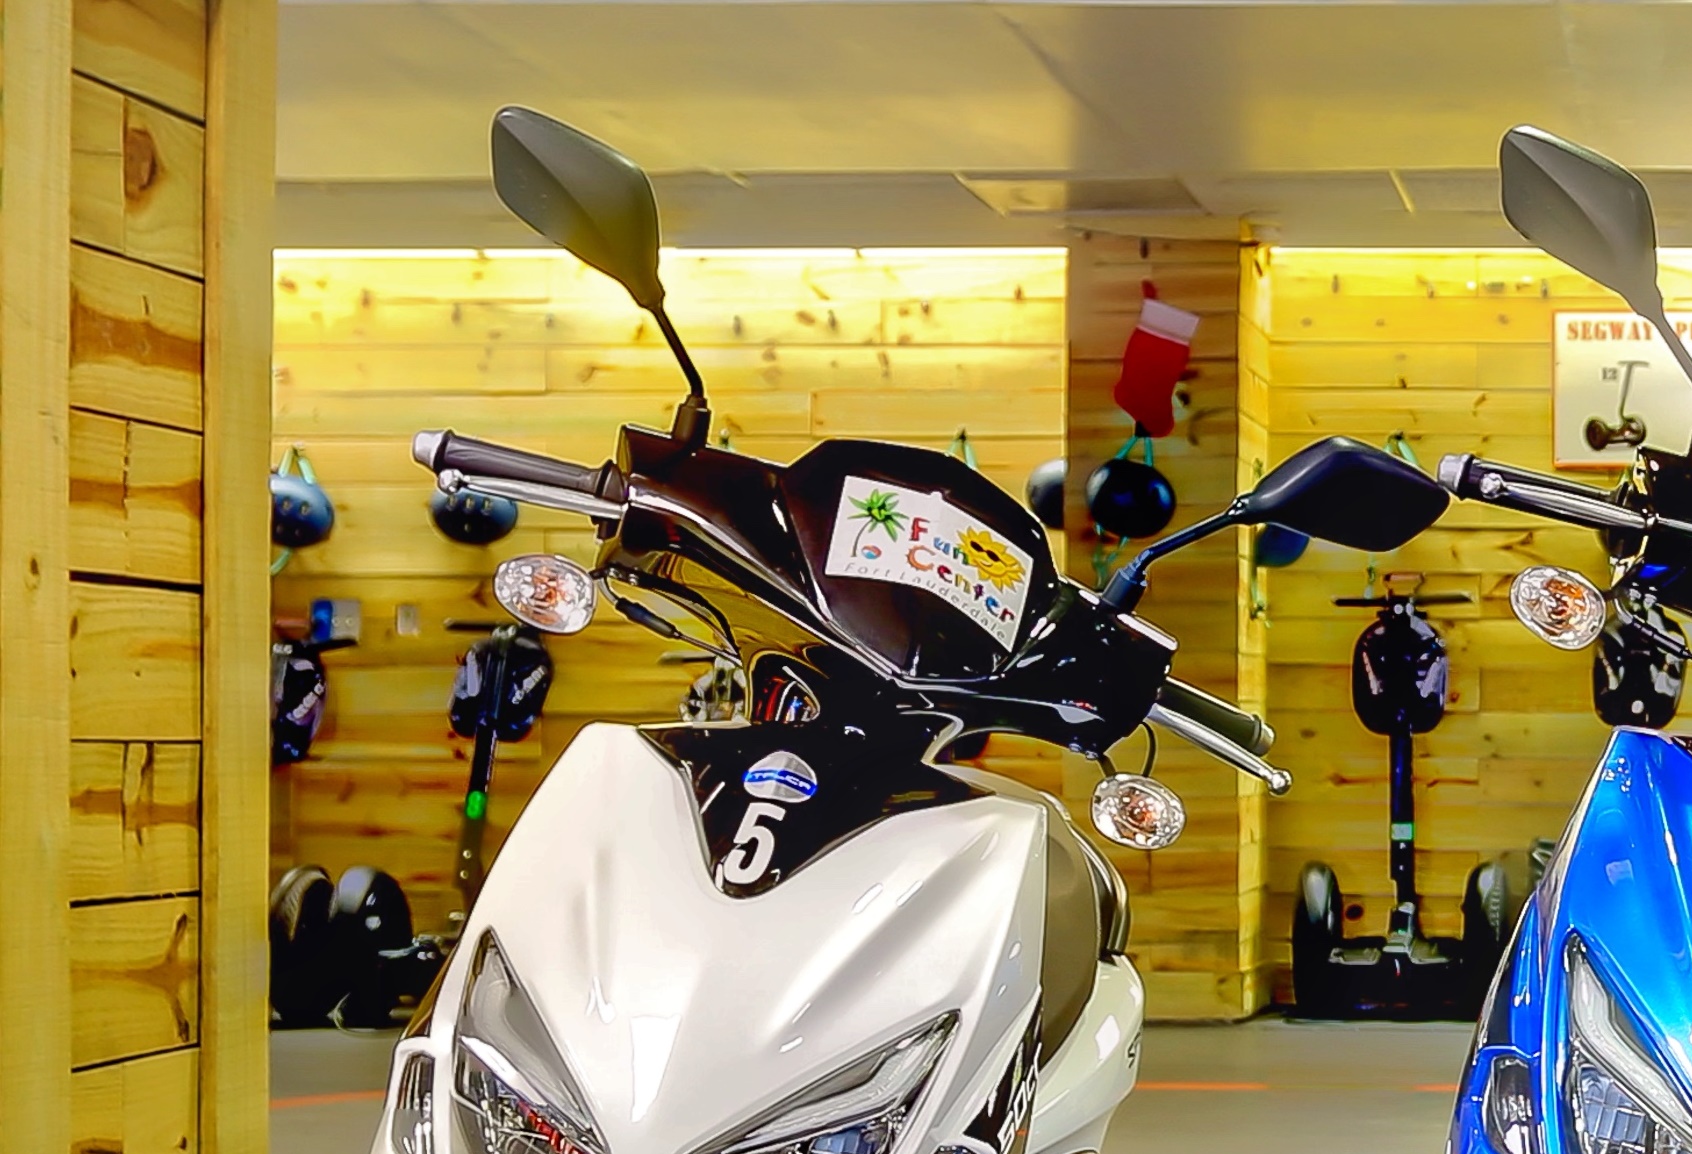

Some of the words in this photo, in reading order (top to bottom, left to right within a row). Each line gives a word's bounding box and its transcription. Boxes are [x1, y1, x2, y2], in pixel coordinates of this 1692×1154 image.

[1567, 320, 1653, 341] SEGWAY
[909, 517, 970, 565] Fun
[844, 563, 890, 577] Fort
[899, 572, 1006, 640] Lauderdale
[905, 545, 1015, 623] Center
[723, 802, 786, 884] 5
